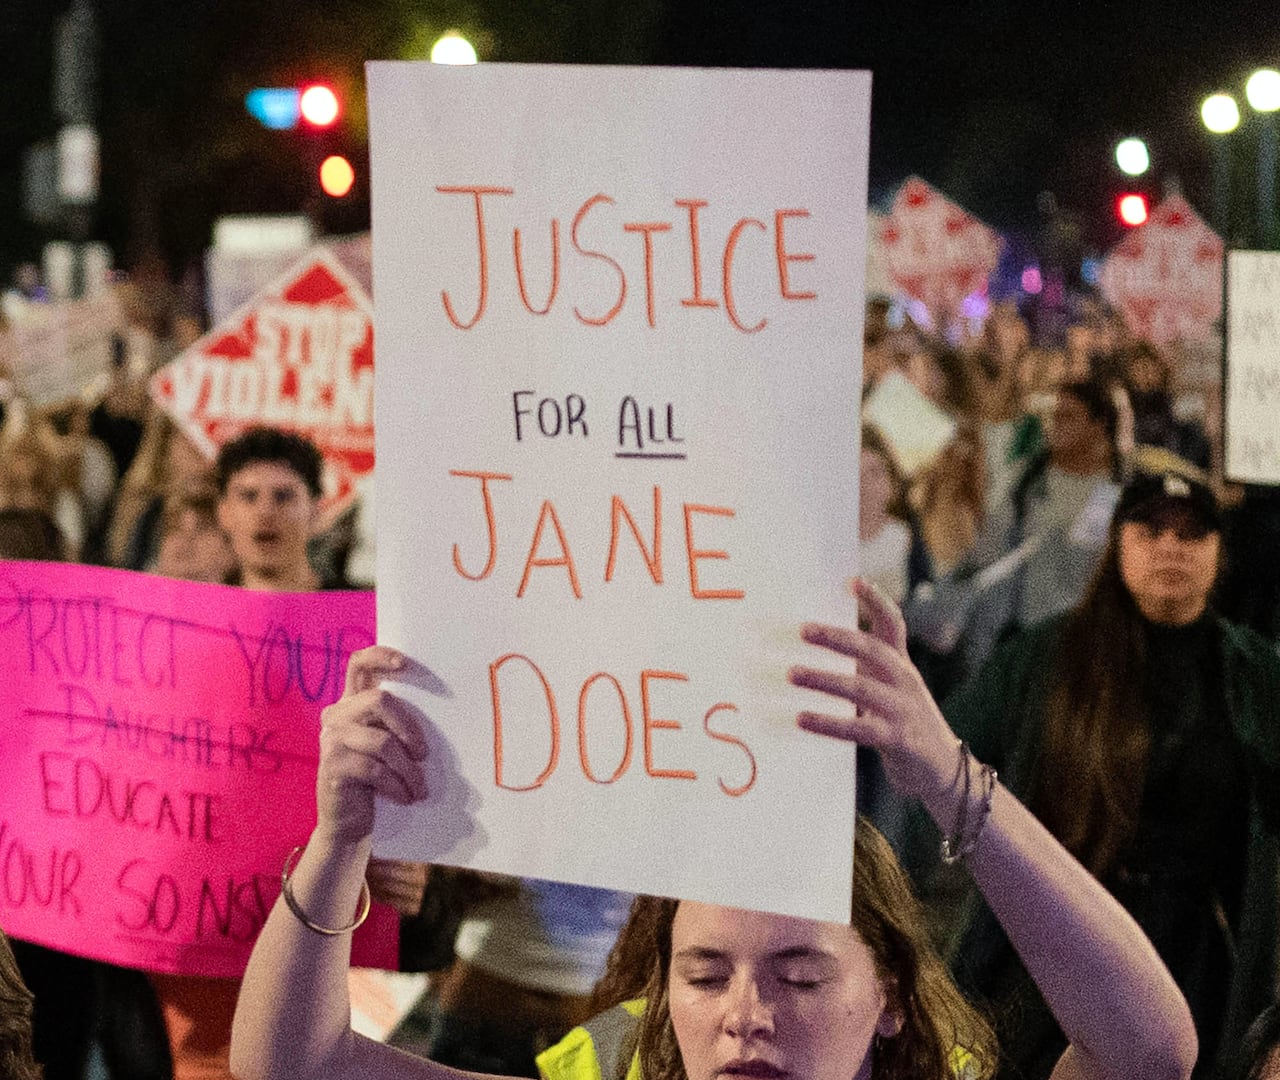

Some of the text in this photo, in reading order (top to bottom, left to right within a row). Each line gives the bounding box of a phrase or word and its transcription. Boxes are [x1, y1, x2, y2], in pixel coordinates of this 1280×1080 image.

[436, 186, 817, 332] JUSTICE
[512, 390, 684, 448] FOR ALL
[450, 470, 745, 600] JANE
[489, 653, 758, 797] DOES
[40, 751, 226, 844] EDUCATE
